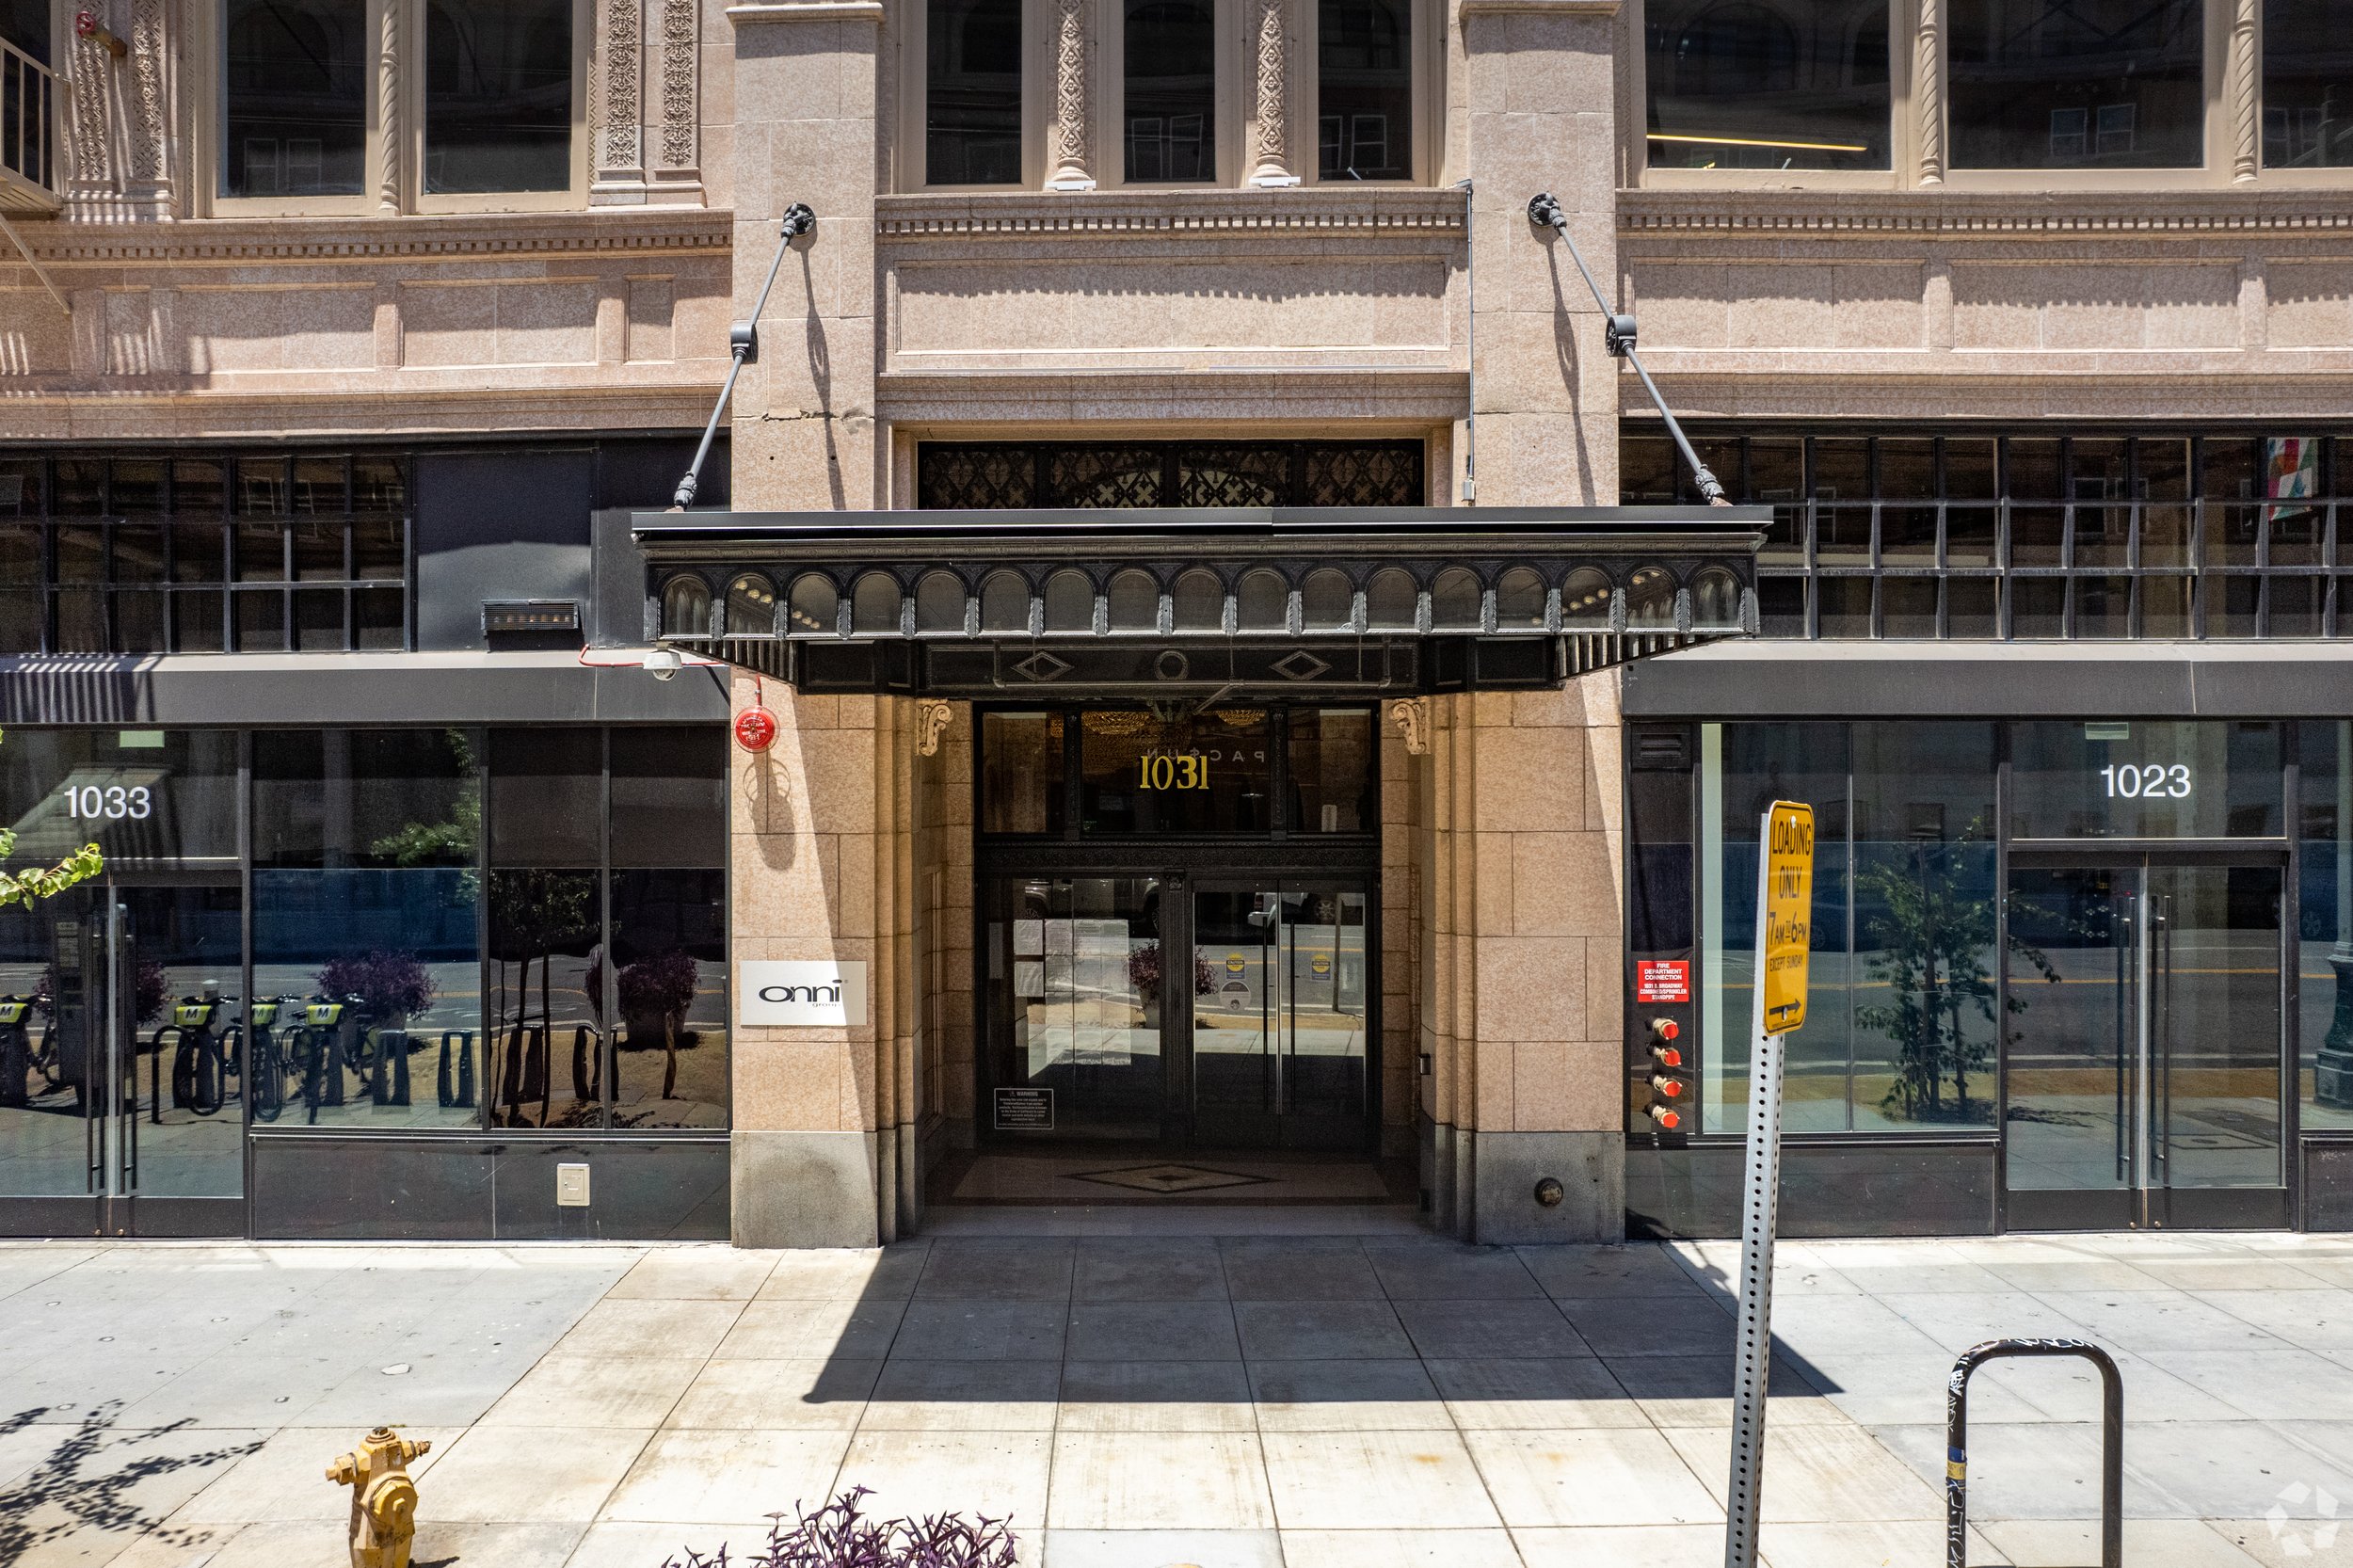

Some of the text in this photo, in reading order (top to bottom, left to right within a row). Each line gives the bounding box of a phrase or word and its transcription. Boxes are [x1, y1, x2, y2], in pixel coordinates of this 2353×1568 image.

[1139, 755, 1209, 791] 1031
[2100, 763, 2192, 799] 1023
[63, 785, 152, 820] 1033
[1772, 820, 1812, 856] LOADING
[1778, 865, 1802, 900] ONLY
[1769, 953, 1803, 972] EXCEPT SUNDAY
[759, 979, 843, 1002] onni
[185, 1008, 199, 1018] M
